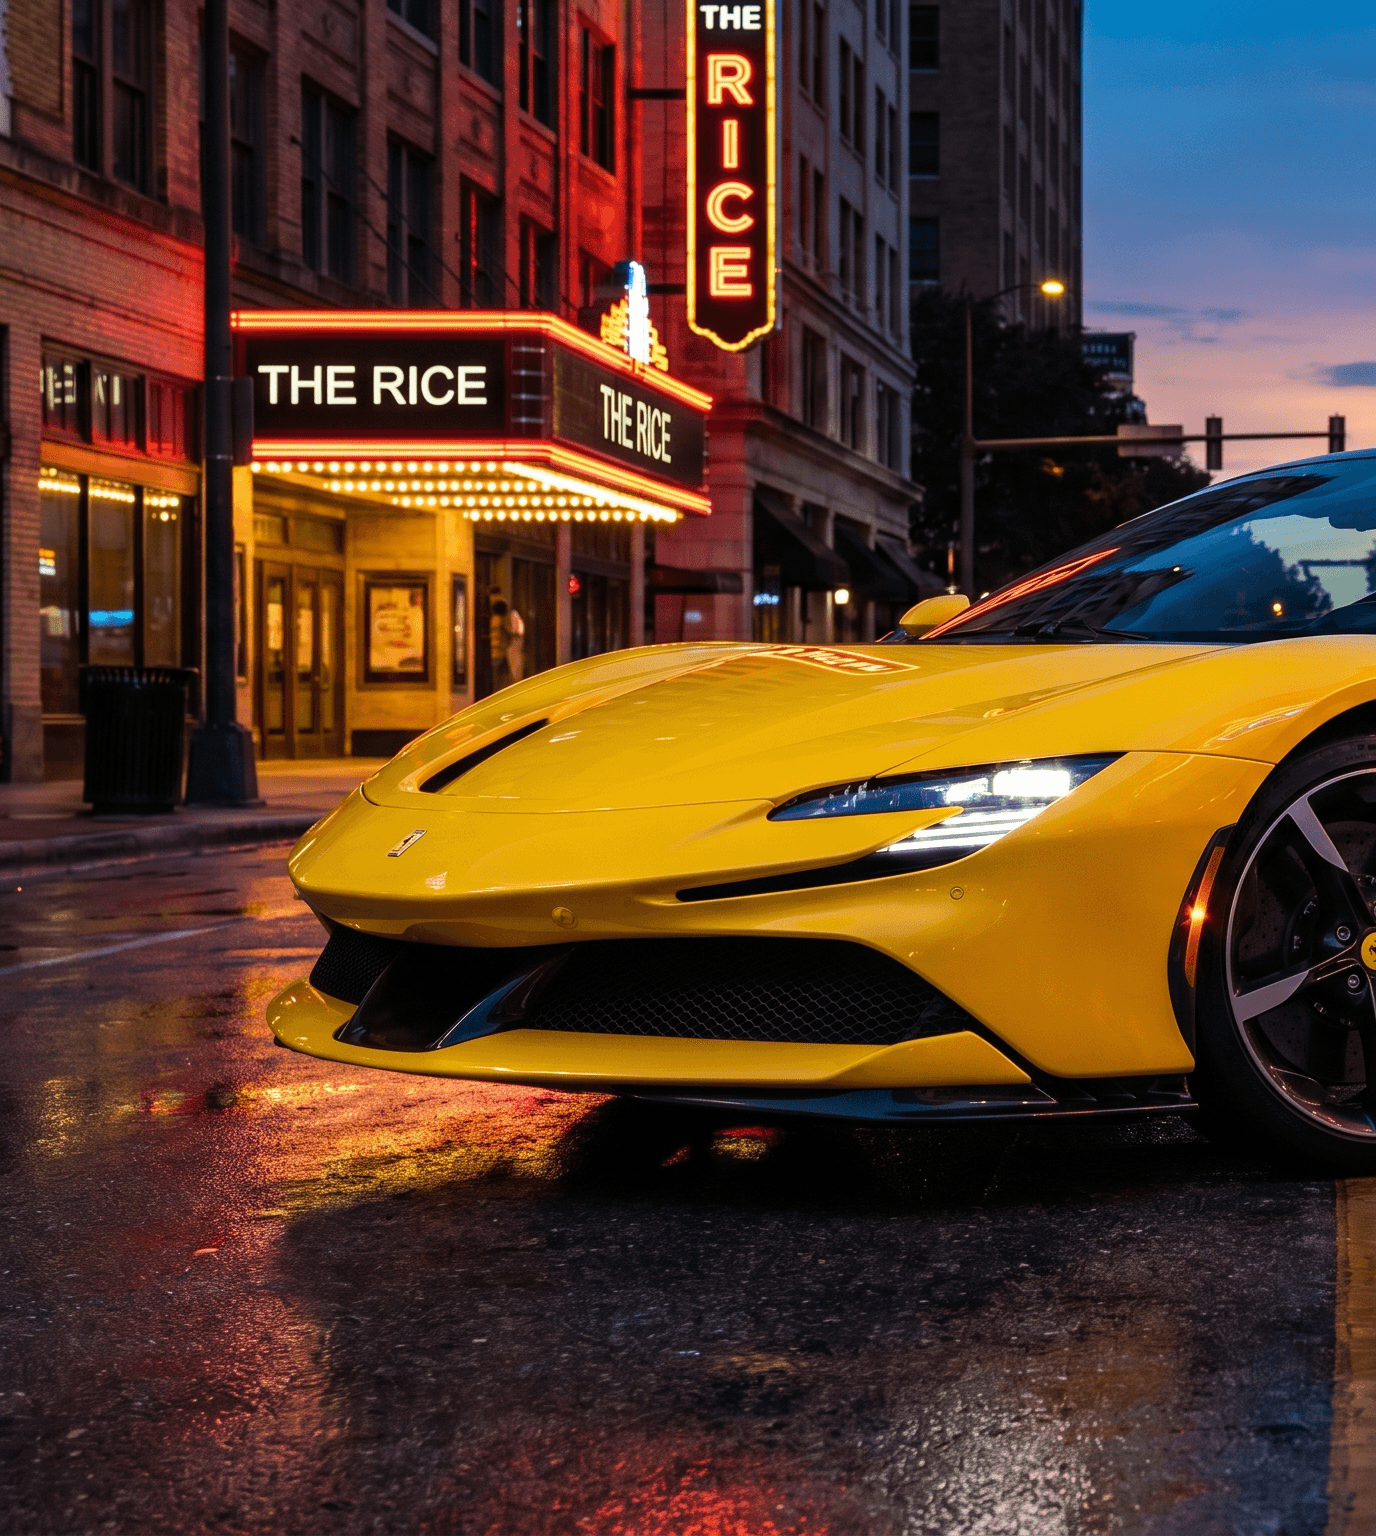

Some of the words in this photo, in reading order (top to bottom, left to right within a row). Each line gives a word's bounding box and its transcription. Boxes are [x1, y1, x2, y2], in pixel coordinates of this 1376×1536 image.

[700, 5, 761, 30] THE
[706, 53, 754, 297] RICE
[258, 365, 357, 405] THE
[373, 365, 488, 405] RICE
[600, 384, 634, 448] THE
[636, 400, 671, 464] RICE
